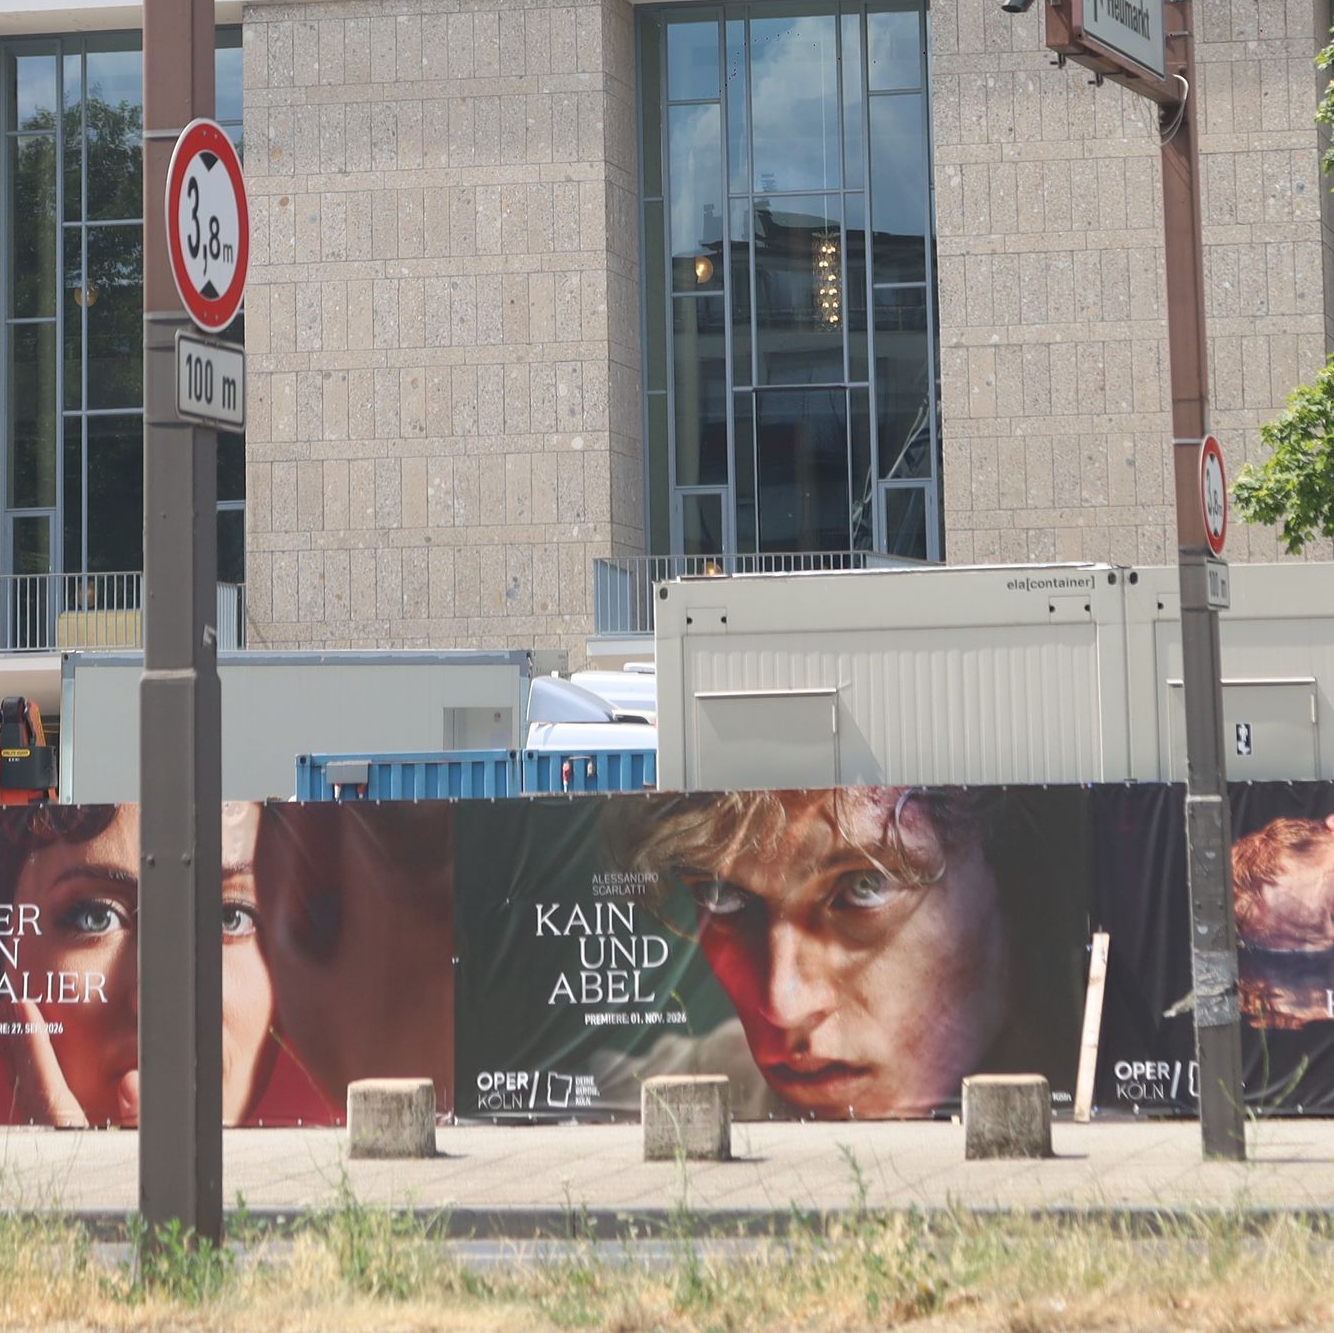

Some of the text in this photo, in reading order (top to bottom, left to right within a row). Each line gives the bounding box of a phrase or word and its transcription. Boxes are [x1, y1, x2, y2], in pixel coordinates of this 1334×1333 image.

[186, 353, 237, 411] 100 m
[1007, 575, 1095, 591] ela[container]
[592, 873, 659, 884] ALESSANDRO
[592, 885, 646, 896] SCARLATTI
[535, 902, 635, 936] KAIN
[579, 935, 669, 969] UND
[548, 970, 656, 1005] ABEL
[630, 1012, 644, 1024] 01.
[667, 1011, 687, 1023] 2026
[1114, 1060, 1170, 1080] OPER
[477, 1071, 529, 1091] OPER
[1117, 1080, 1164, 1099] KÖLN
[478, 1090, 522, 1109] KÖLN
